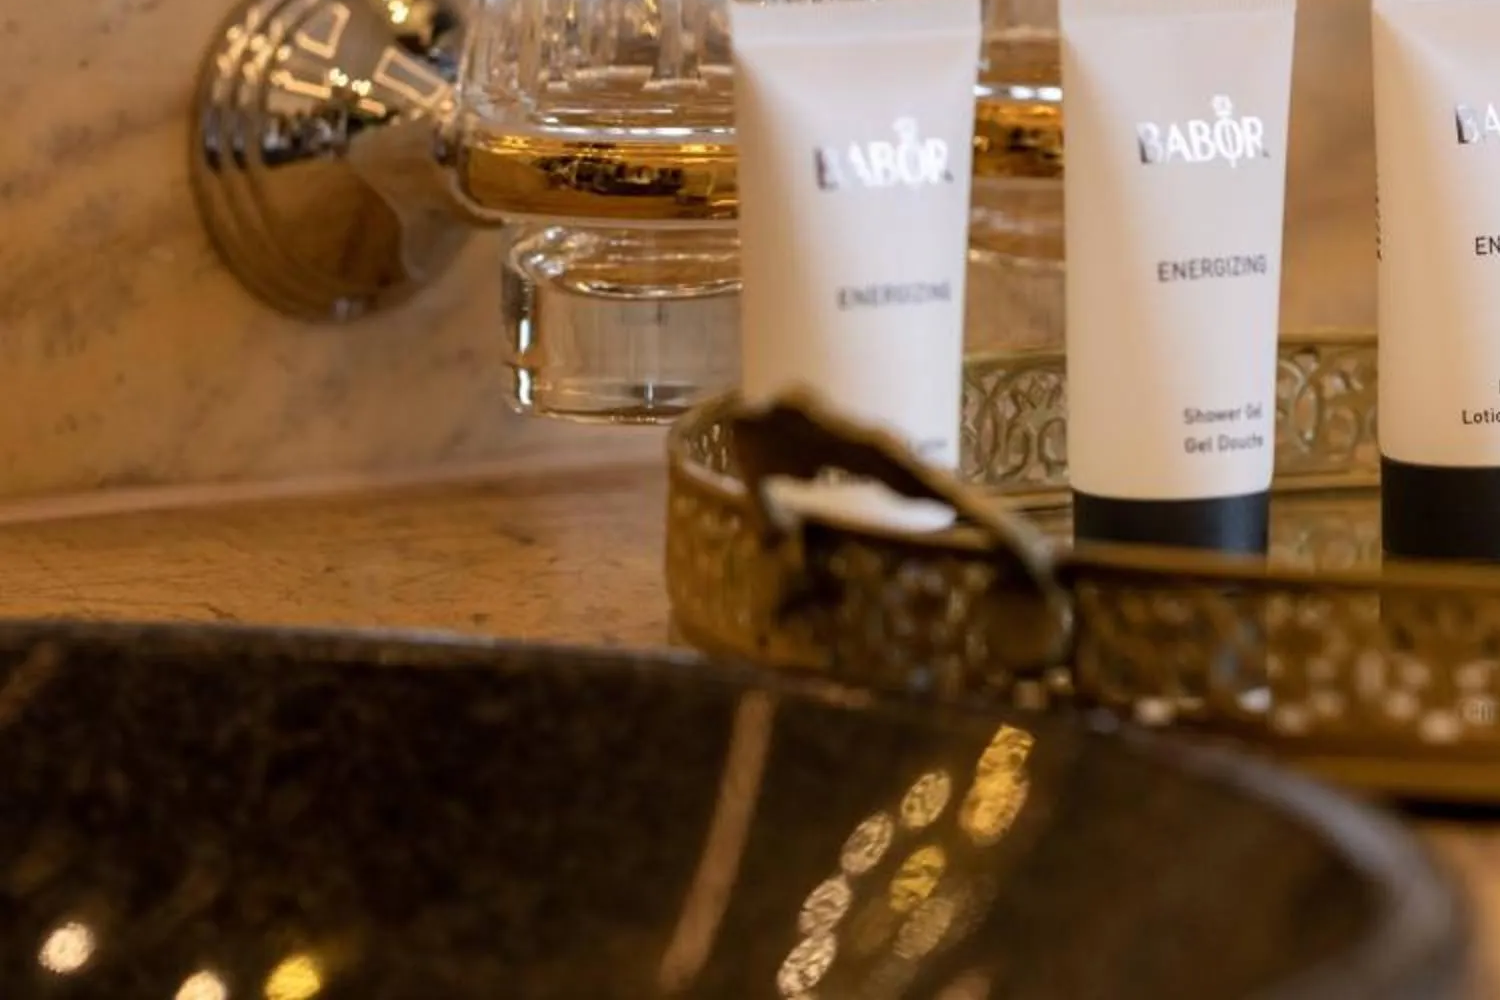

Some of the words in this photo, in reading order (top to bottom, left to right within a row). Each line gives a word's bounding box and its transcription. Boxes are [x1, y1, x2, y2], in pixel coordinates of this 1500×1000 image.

[1136, 111, 1270, 167] BABOR
[1157, 253, 1267, 283] ENERGIZING
[1183, 406, 1241, 425] Shower
[1183, 437, 1213, 454] Gel
